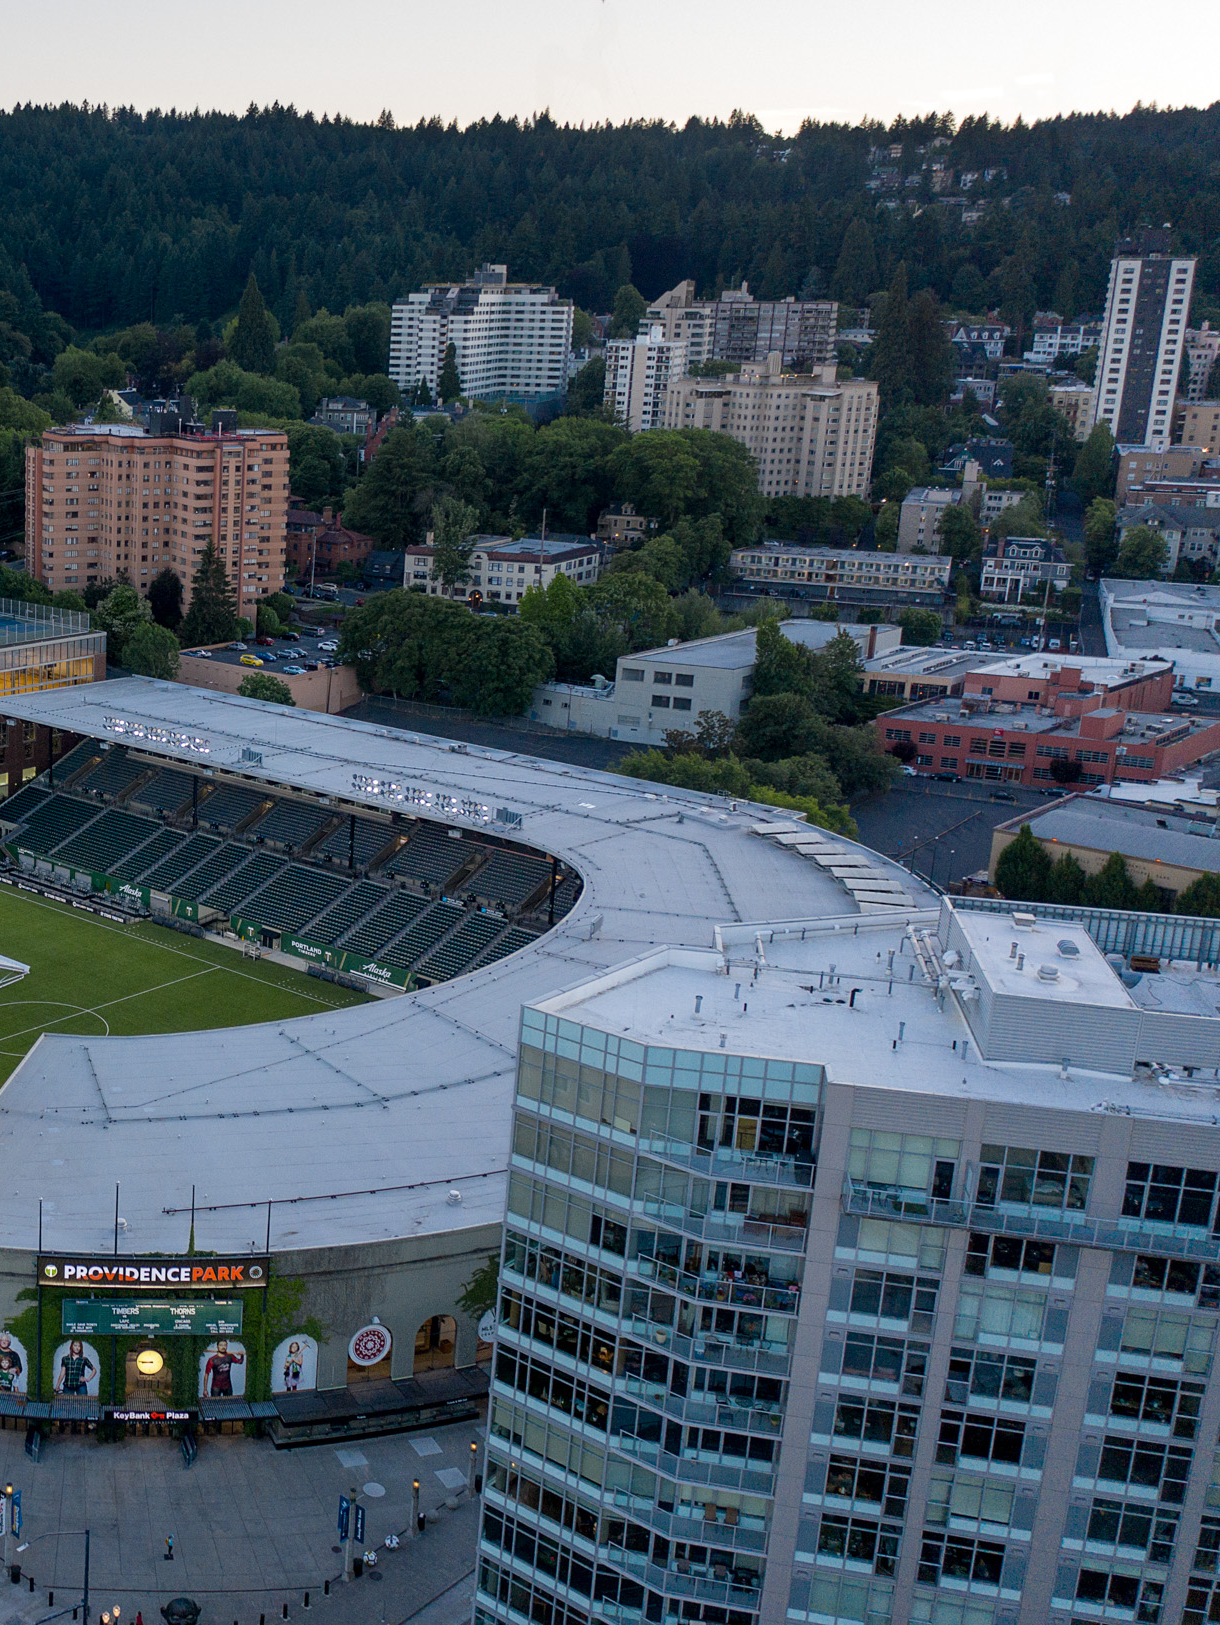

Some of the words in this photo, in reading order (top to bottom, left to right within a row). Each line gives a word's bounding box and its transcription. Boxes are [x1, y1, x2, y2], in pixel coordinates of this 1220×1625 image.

[119, 884, 142, 898] Alaska
[291, 941, 322, 955] PORTLAND
[363, 963, 391, 978] Alaska
[64, 1265, 191, 1281] PROVIDENCE
[192, 1266, 245, 1281] PARK
[113, 1411, 151, 1420] KeyBank
